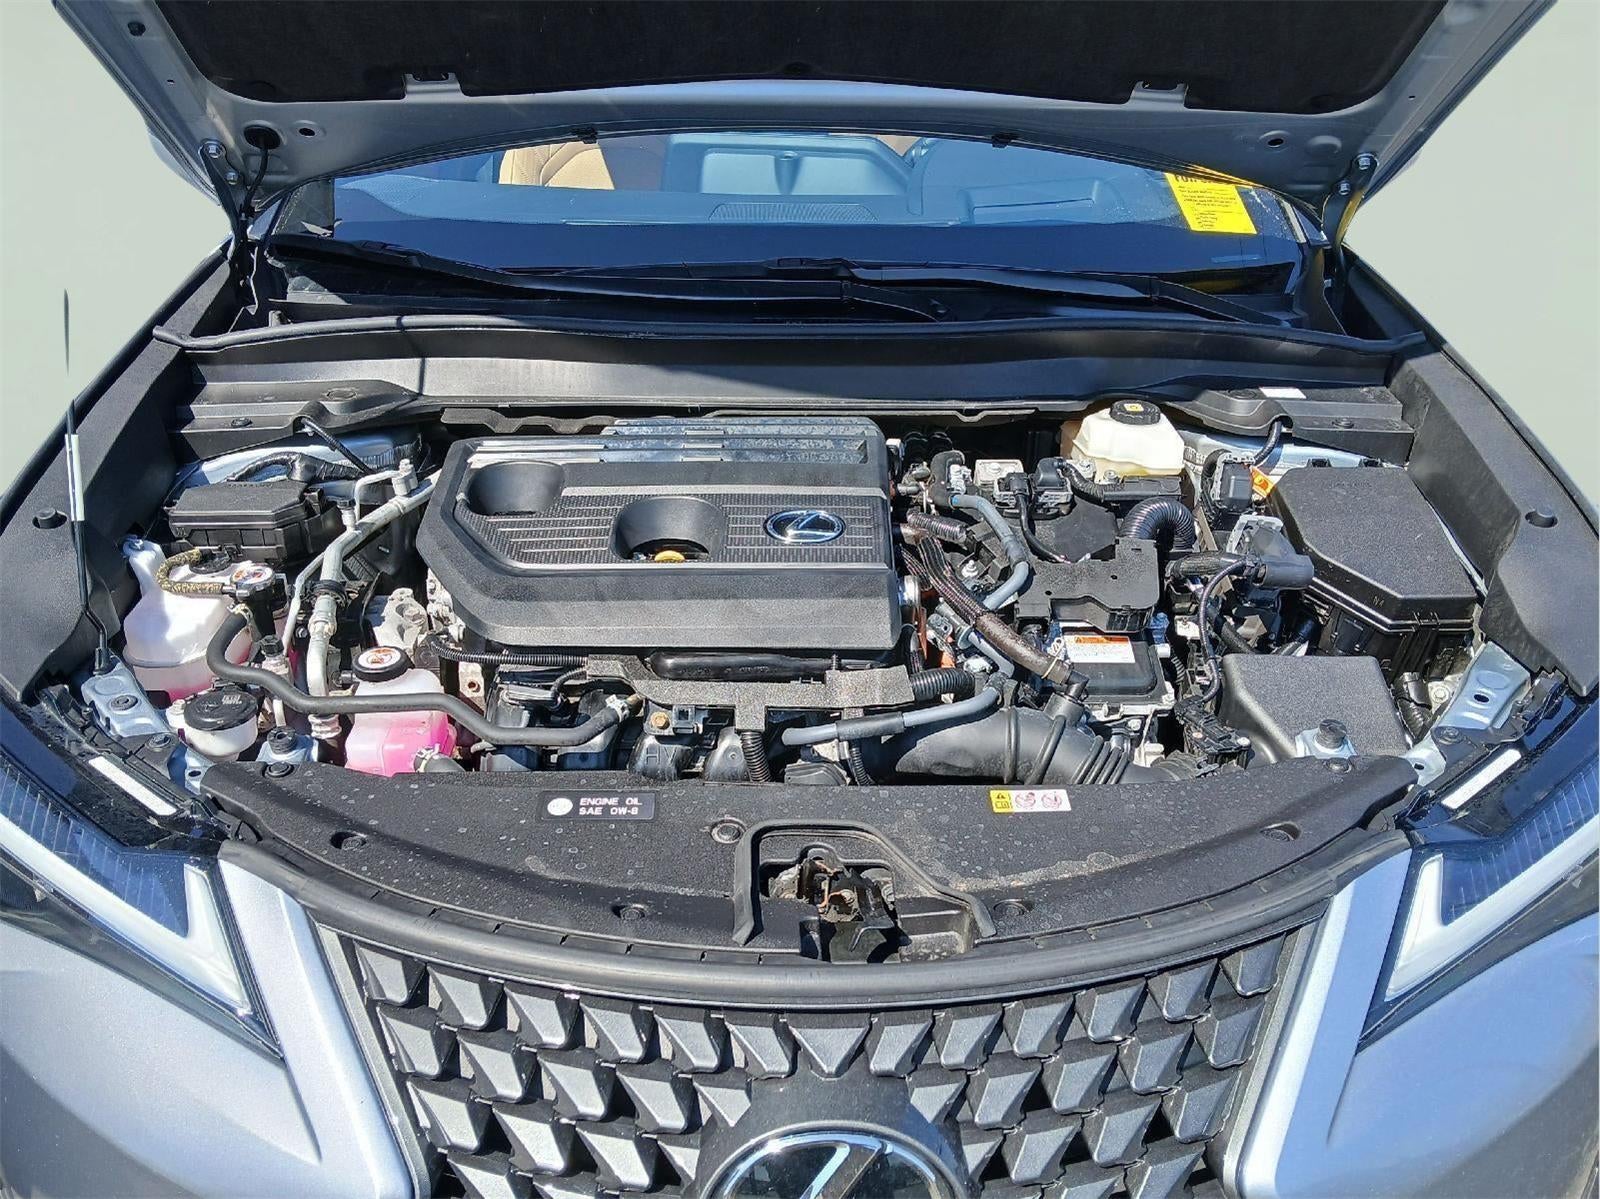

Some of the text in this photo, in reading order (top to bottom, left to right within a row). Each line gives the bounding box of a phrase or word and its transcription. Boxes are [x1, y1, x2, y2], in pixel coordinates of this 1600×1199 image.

[579, 797, 643, 806] ENGINE OIL
[578, 806, 603, 815] SAE
